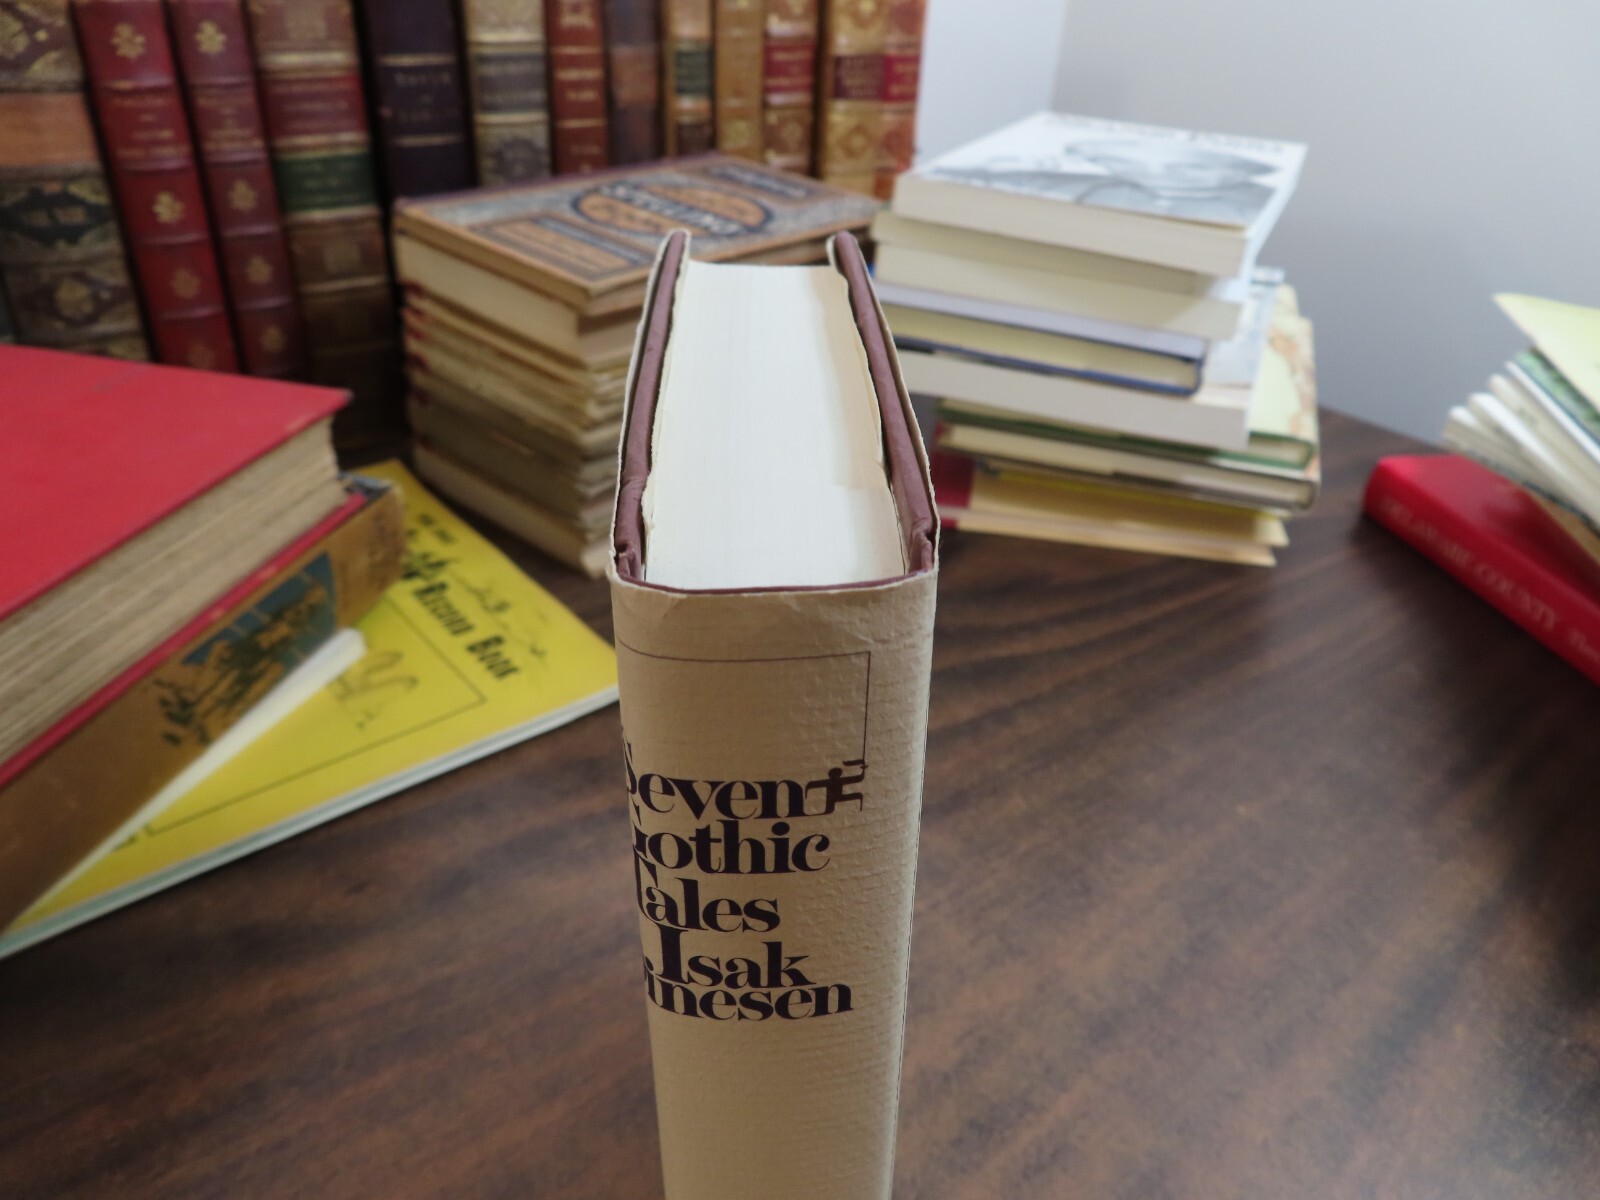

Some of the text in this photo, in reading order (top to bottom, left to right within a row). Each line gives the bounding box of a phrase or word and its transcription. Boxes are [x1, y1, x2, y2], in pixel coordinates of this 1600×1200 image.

[623, 737, 808, 820] Seven
[633, 845, 781, 933] Tales
[643, 956, 854, 1021] inesen
[653, 920, 817, 990] Isak
